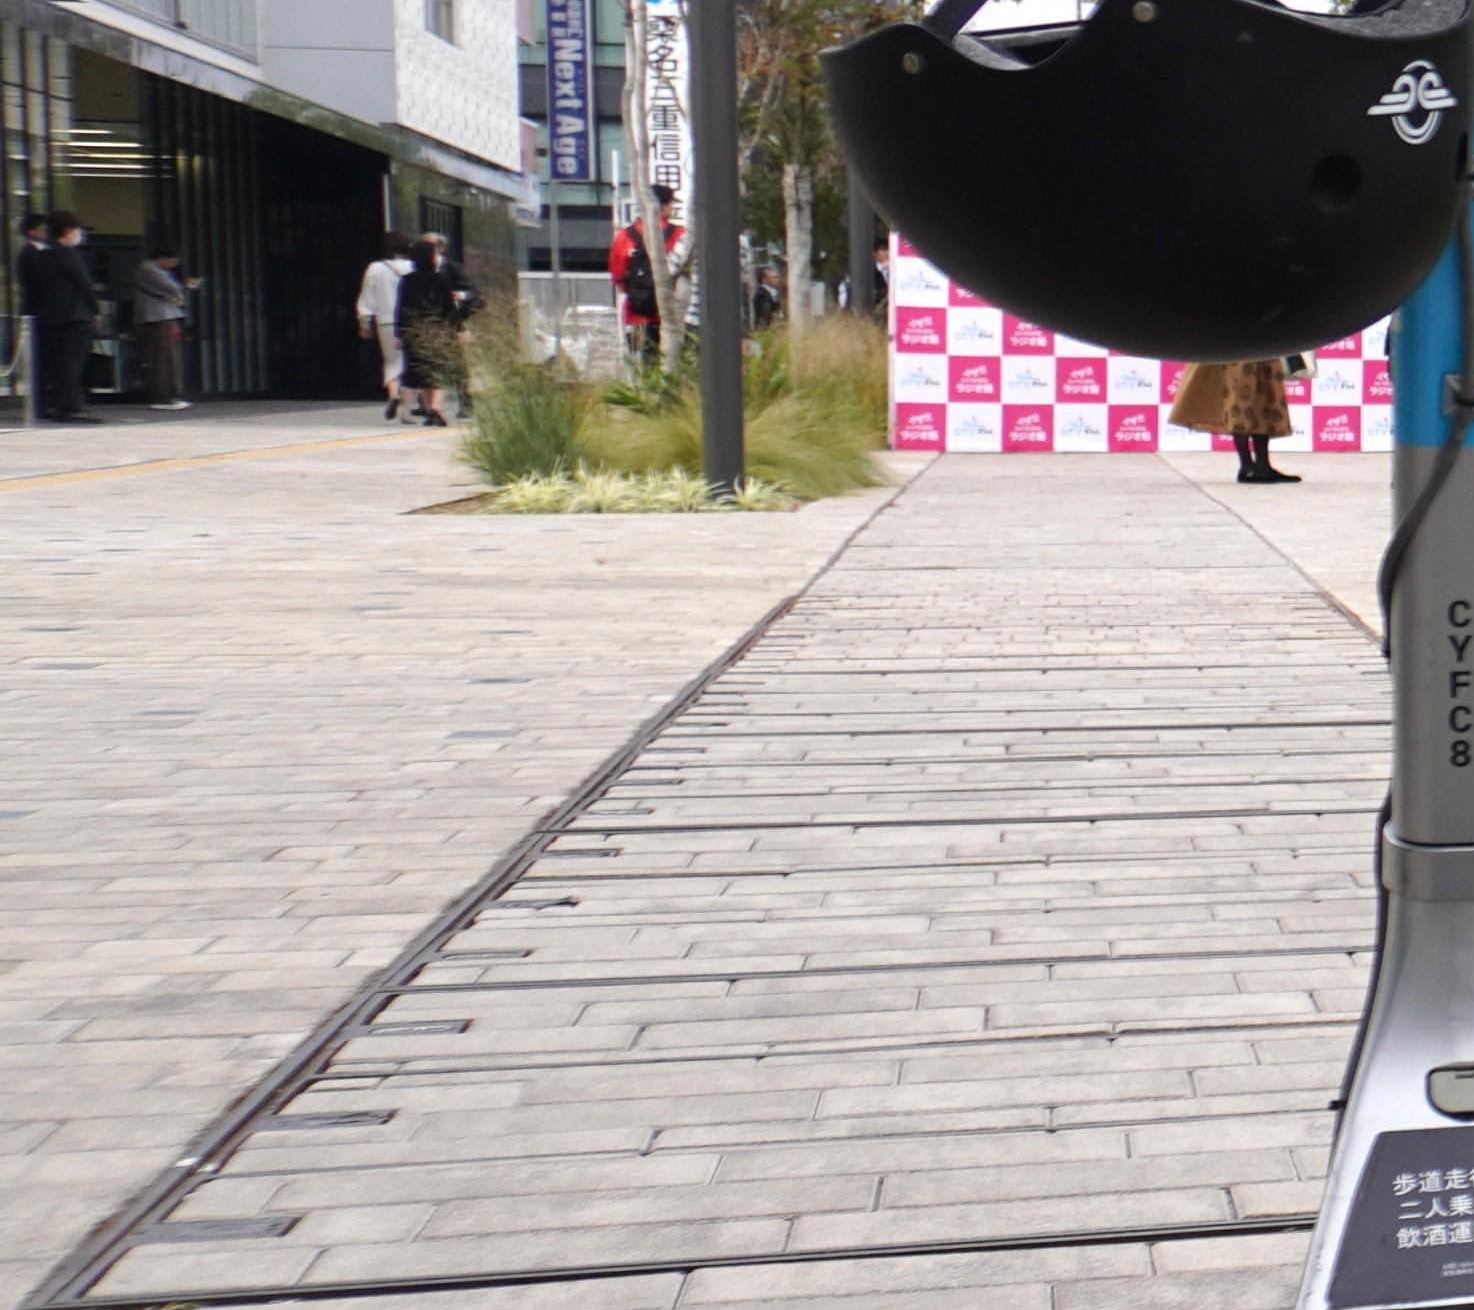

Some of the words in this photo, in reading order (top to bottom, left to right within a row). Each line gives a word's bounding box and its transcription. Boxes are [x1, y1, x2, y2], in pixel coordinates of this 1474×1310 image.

[553, 39, 583, 108] Next
[553, 115, 585, 175] Age
[1447, 599, 1473, 768] CYFC8
